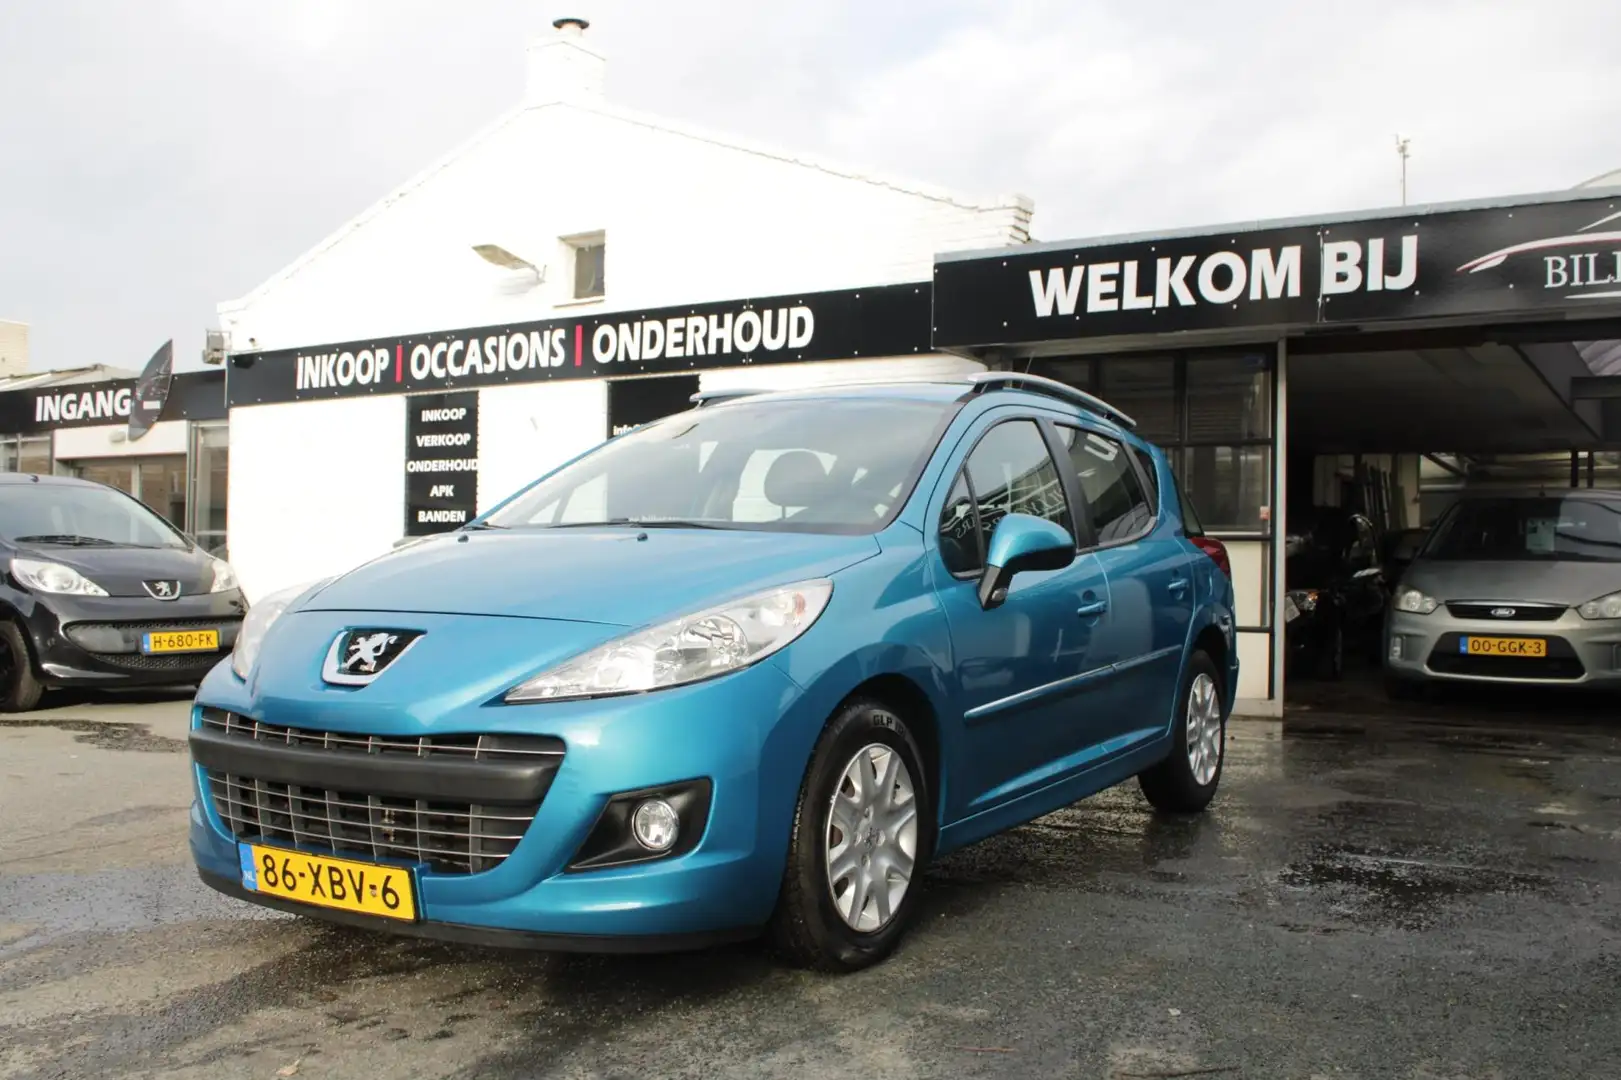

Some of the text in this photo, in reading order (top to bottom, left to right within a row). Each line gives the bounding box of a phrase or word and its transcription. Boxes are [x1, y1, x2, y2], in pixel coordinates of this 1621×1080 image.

[1028, 234, 1418, 318] WELKOM BIJ
[296, 306, 815, 390] INKOOP OCCASIONS ONDERHOUD
[35, 388, 131, 422] INGANG
[421, 407, 467, 422] INKOOP
[415, 433, 472, 448] VERKOOP
[407, 459, 478, 472] ONDERHOUD
[429, 485, 455, 497] APK
[417, 510, 467, 522] BANDEN
[153, 633, 214, 649] H-680-FK
[262, 853, 401, 910] 86-XBV-6
